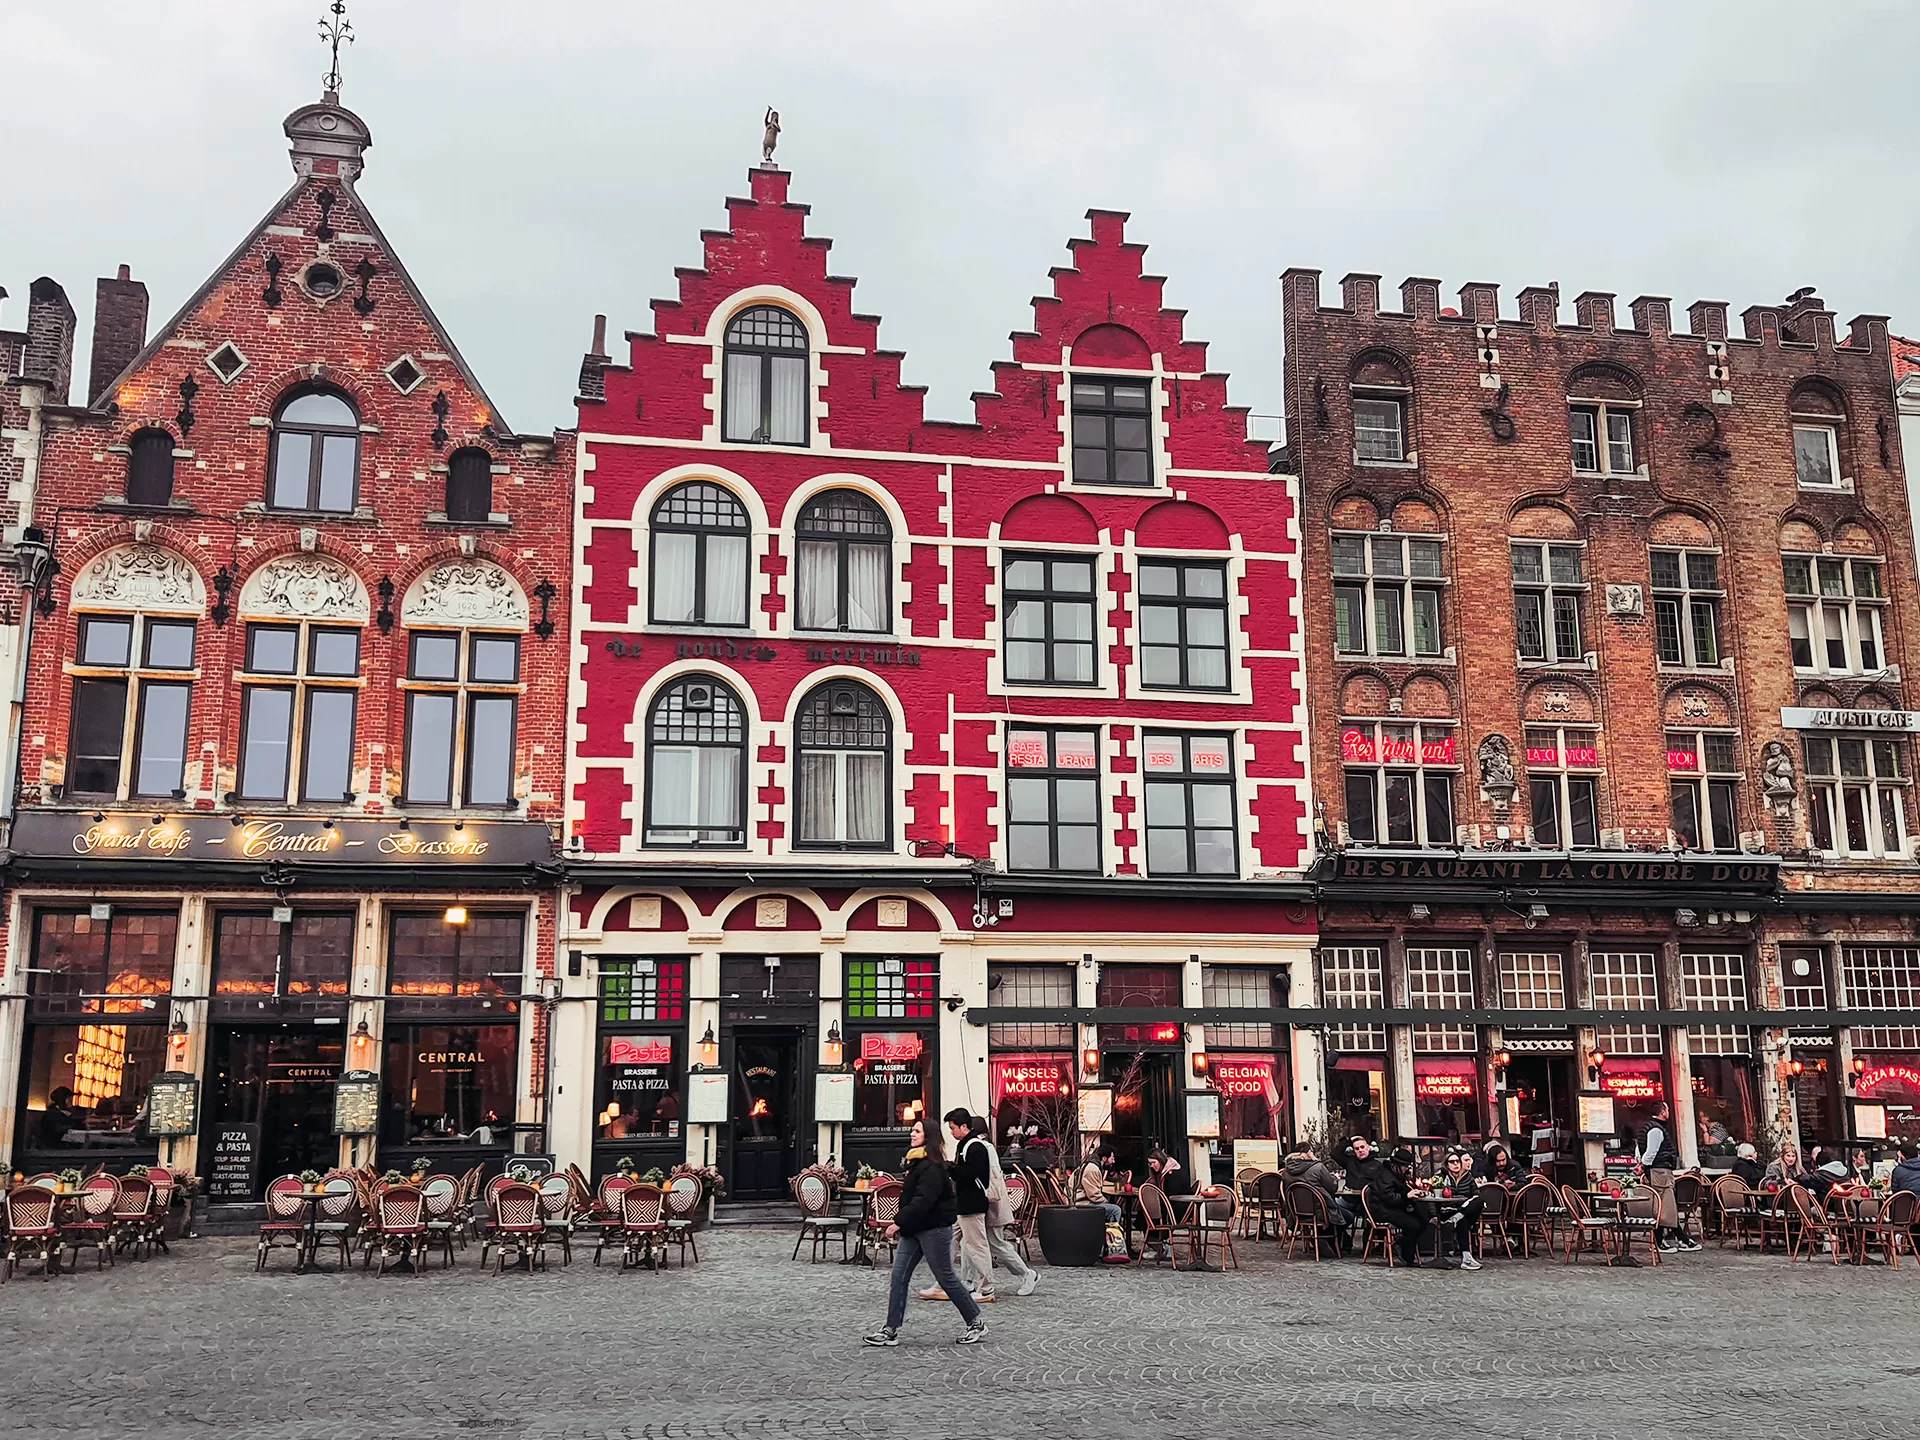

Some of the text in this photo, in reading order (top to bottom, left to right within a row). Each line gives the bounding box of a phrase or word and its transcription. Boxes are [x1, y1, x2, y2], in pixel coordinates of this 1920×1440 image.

[1011, 743, 1042, 753] CAFE
[1149, 753, 1173, 765] DES
[1193, 754, 1223, 766] ARTS
[72, 827, 145, 854] Grand
[242, 820, 333, 858] Central
[377, 833, 489, 855] Brasserie
[1343, 859, 1769, 881] RESTAURANT LA CIVIERE D'OR
[611, 1040, 671, 1062] Pasta
[864, 1037, 916, 1058] Pizza
[64, 1053, 136, 1064] CENTRAL
[418, 1052, 486, 1063] CENTRAL
[288, 1068, 332, 1077] CENTRAL
[623, 1068, 658, 1076] BRASSERIE
[1002, 1067, 1059, 1079] MUSSELS
[1219, 1067, 1270, 1079] BELGIAN
[612, 1079, 669, 1090] PASTA & PIZZA
[864, 1074, 888, 1085] PASTA
[889, 1075, 895, 1085] &
[895, 1074, 918, 1085] PIZZA
[1860, 1068, 1888, 1092] PIZZA
[1005, 1081, 1056, 1093] MOULES
[1228, 1080, 1262, 1093] FOOD
[222, 1131, 247, 1141] PIZZA
[215, 1142, 251, 1152] & PASTA
